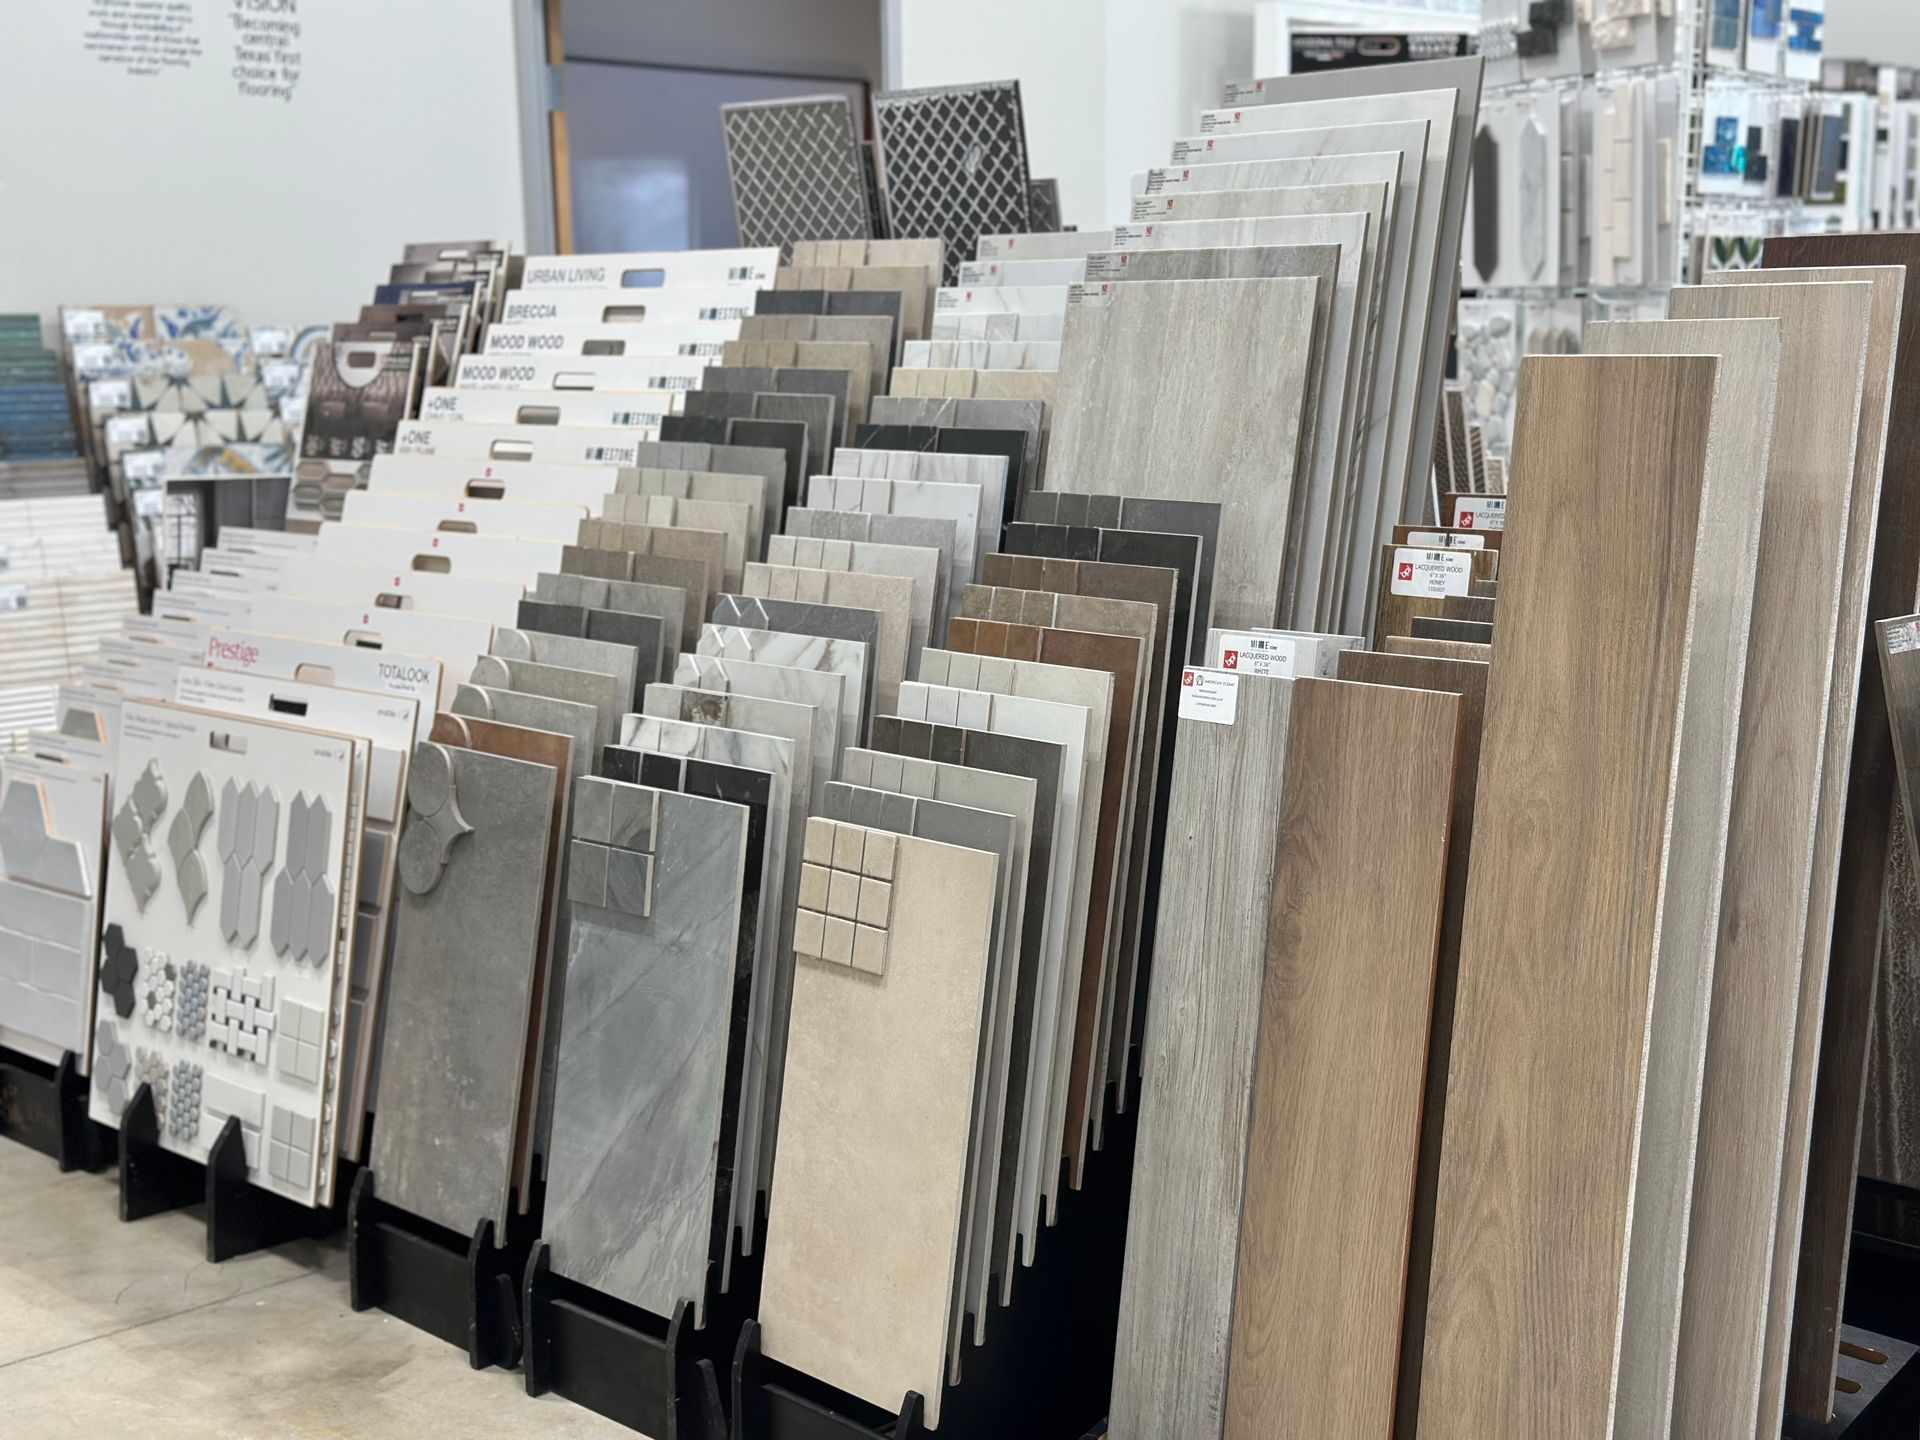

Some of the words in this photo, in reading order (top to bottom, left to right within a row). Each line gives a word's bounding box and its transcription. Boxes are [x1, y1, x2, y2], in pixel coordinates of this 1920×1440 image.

[527, 268, 567, 284] URBAN
[568, 267, 605, 283] LIVING
[507, 305, 557, 319] BRECCIA
[490, 335, 525, 349] MOOD
[527, 335, 564, 349] WOOD
[462, 366, 497, 381] MOOD
[499, 366, 536, 381] WOOD
[427, 397, 459, 411] +ONE
[401, 430, 432, 445] +ONE
[1415, 564, 1446, 572] LACQUERED
[208, 636, 259, 667] Prestige
[1239, 652, 1270, 660] LACQUERED
[1270, 654, 1287, 662] WOOD
[379, 663, 431, 684] TOTALOOK
